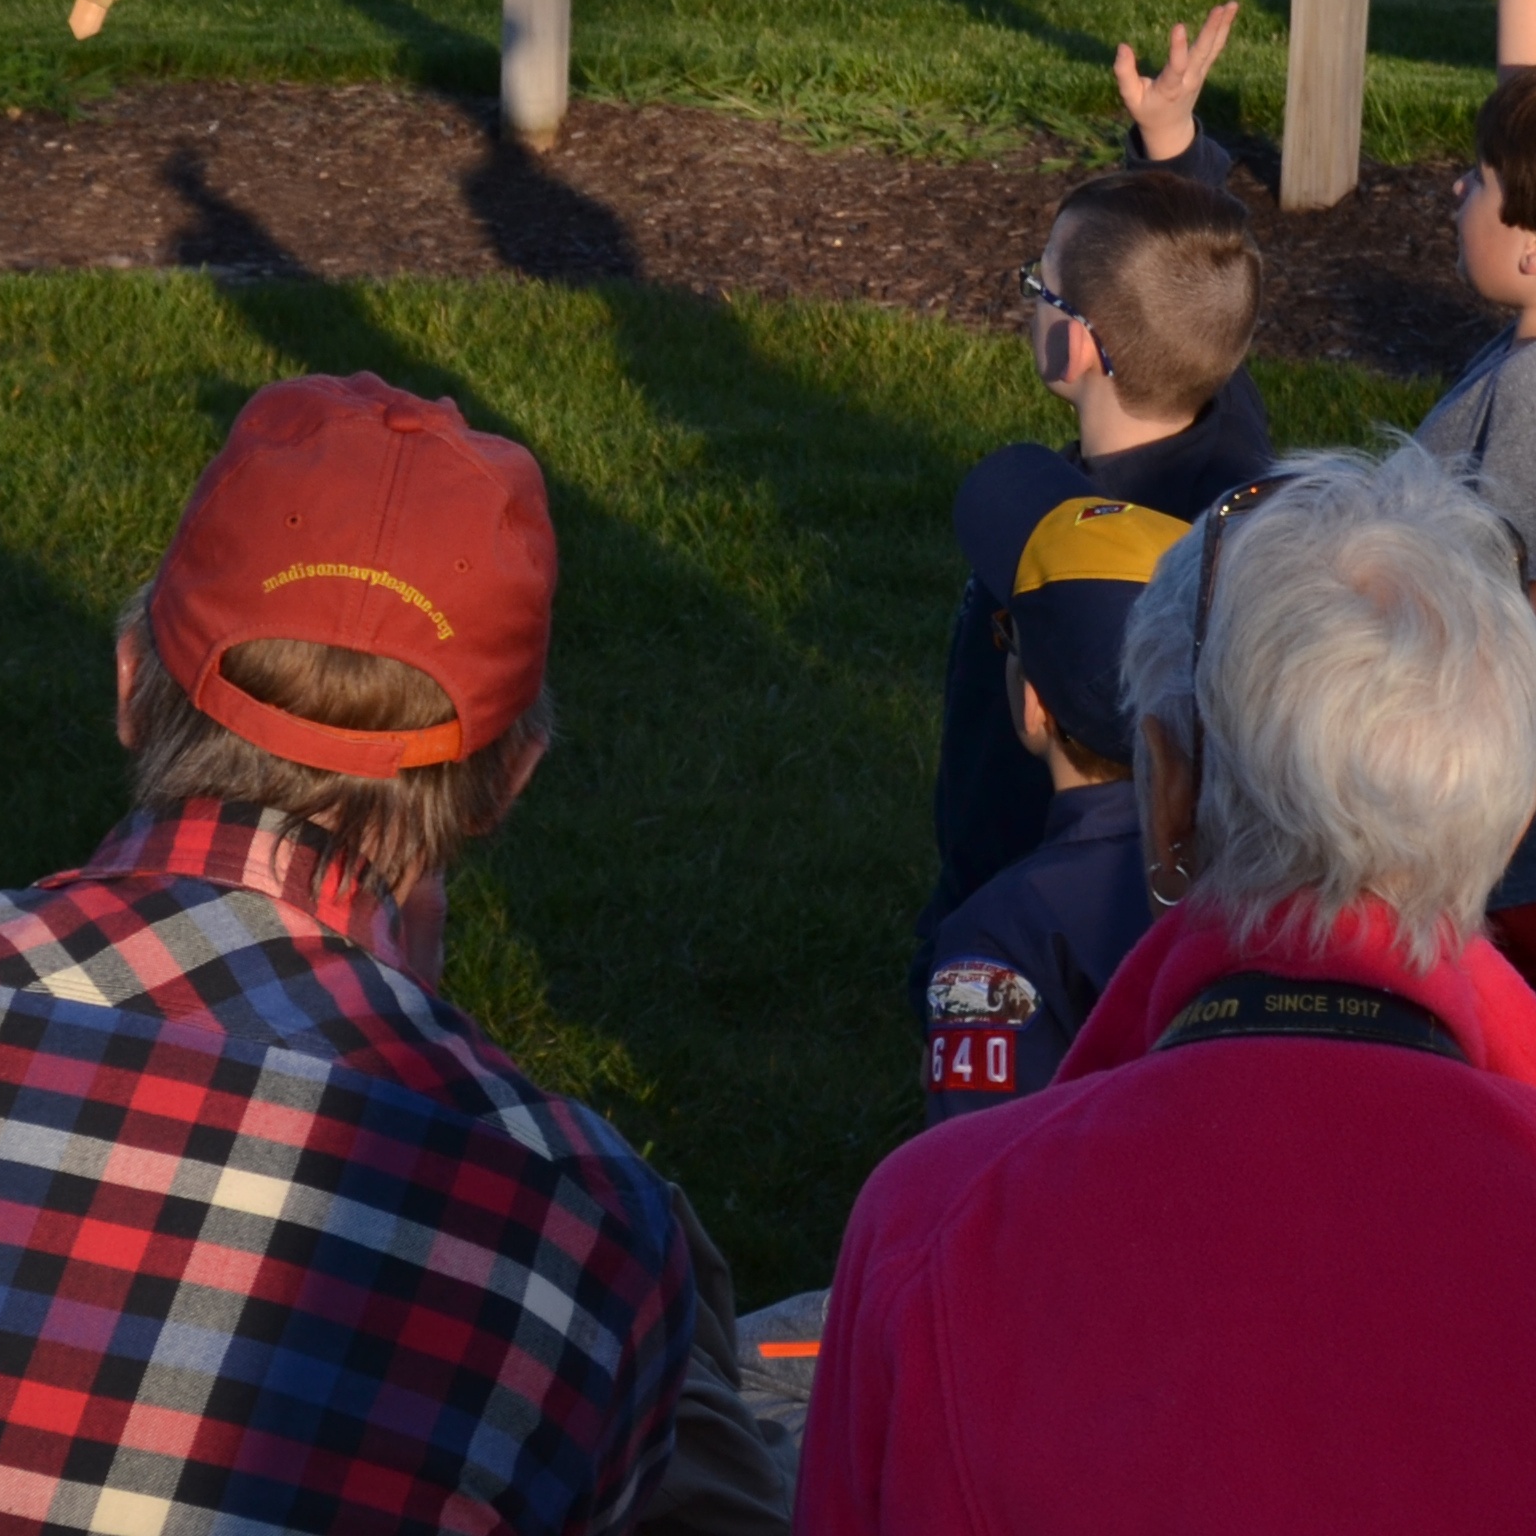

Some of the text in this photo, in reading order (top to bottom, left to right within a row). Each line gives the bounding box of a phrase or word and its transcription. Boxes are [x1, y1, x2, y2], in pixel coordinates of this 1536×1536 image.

[262, 562, 454, 641] madisonnavyleague.org
[1264, 994, 1329, 1013] SINCE
[1336, 997, 1382, 1019] 1917
[932, 1036, 1008, 1084] 640
